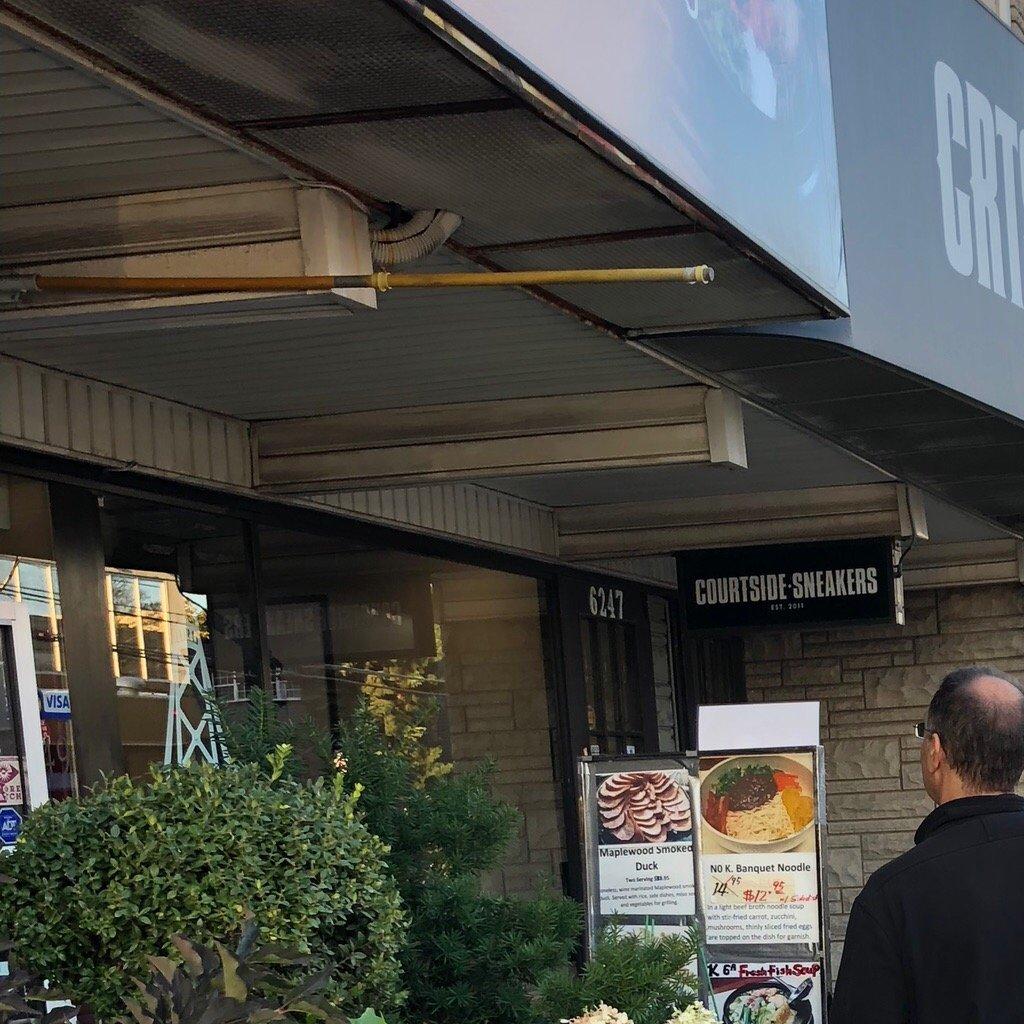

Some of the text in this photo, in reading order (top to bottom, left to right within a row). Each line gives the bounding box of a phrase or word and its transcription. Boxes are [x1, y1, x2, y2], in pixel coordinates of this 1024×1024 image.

[588, 585, 624, 620] 6247
[46, 694, 70, 709] VISA
[600, 847, 654, 858] Maplewood
[635, 860, 659, 871] Duck
[736, 863, 775, 874] Banquet
[777, 862, 811, 872] Noodle
[745, 923, 763, 932] thinly
[782, 922, 797, 930] fried
[776, 932, 786, 940] for
[738, 964, 768, 977] Fresh
[768, 964, 793, 977] Fish
